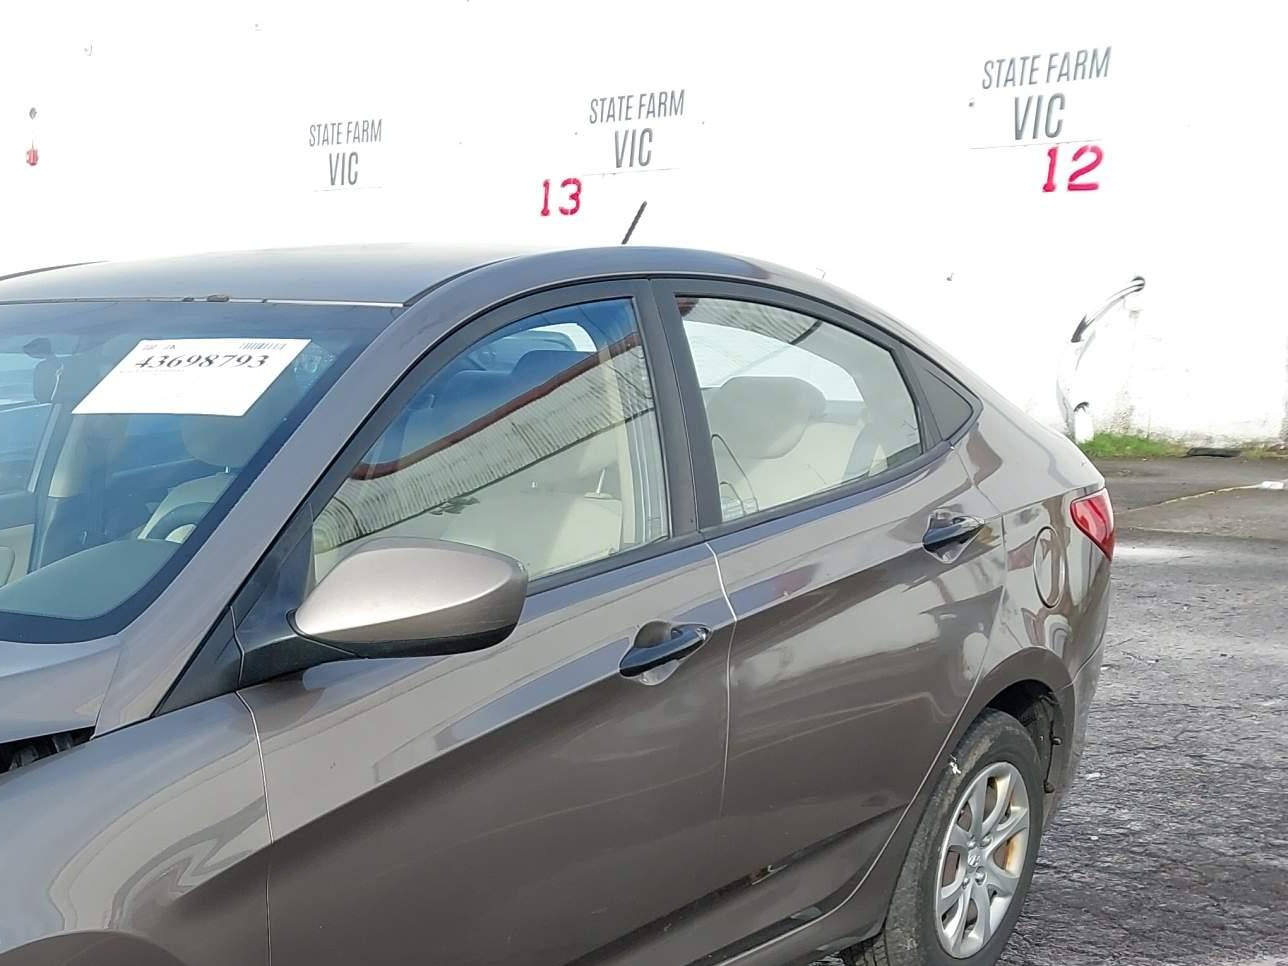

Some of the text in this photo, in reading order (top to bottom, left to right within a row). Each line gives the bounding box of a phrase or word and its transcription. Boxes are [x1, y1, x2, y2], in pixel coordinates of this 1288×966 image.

[981, 47, 1112, 90] STATE FARM
[588, 89, 686, 125] STATE FARM
[1014, 93, 1066, 141] VIC
[309, 119, 382, 147] STATE FARM
[614, 128, 654, 169] VIC
[328, 152, 359, 186] VIC
[1042, 145, 1105, 193] 12
[540, 177, 583, 217] 13
[135, 353, 270, 369] 43698793
